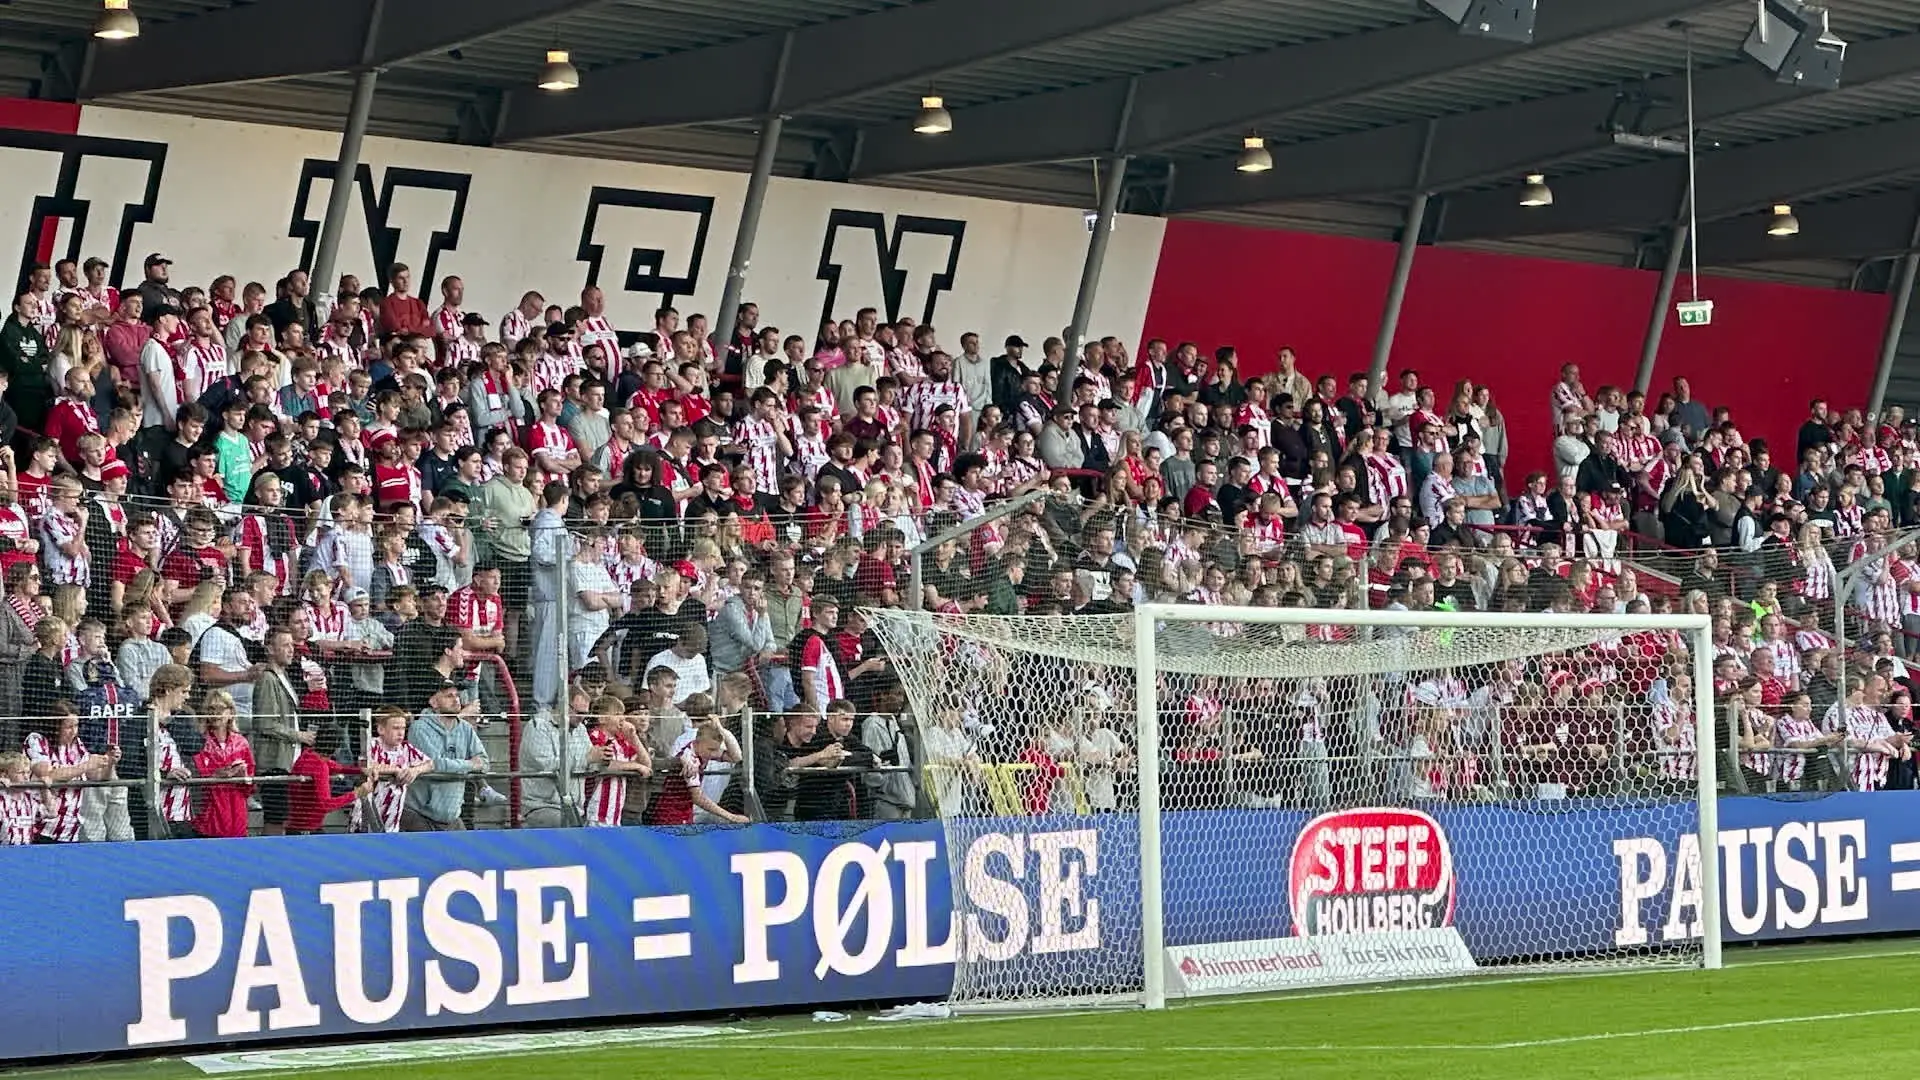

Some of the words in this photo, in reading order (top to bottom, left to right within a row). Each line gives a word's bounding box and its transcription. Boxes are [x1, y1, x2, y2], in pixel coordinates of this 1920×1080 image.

[90, 703, 134, 719] BAPE
[1308, 825, 1430, 893] STEFF
[1613, 819, 1869, 946] PAUSE
[124, 865, 590, 1046] PAUSE
[730, 828, 1100, 984] PØLSE
[1316, 893, 1434, 937] HOULBERG
[1202, 950, 1322, 977] himmerland
[1343, 943, 1449, 965] forsikring
